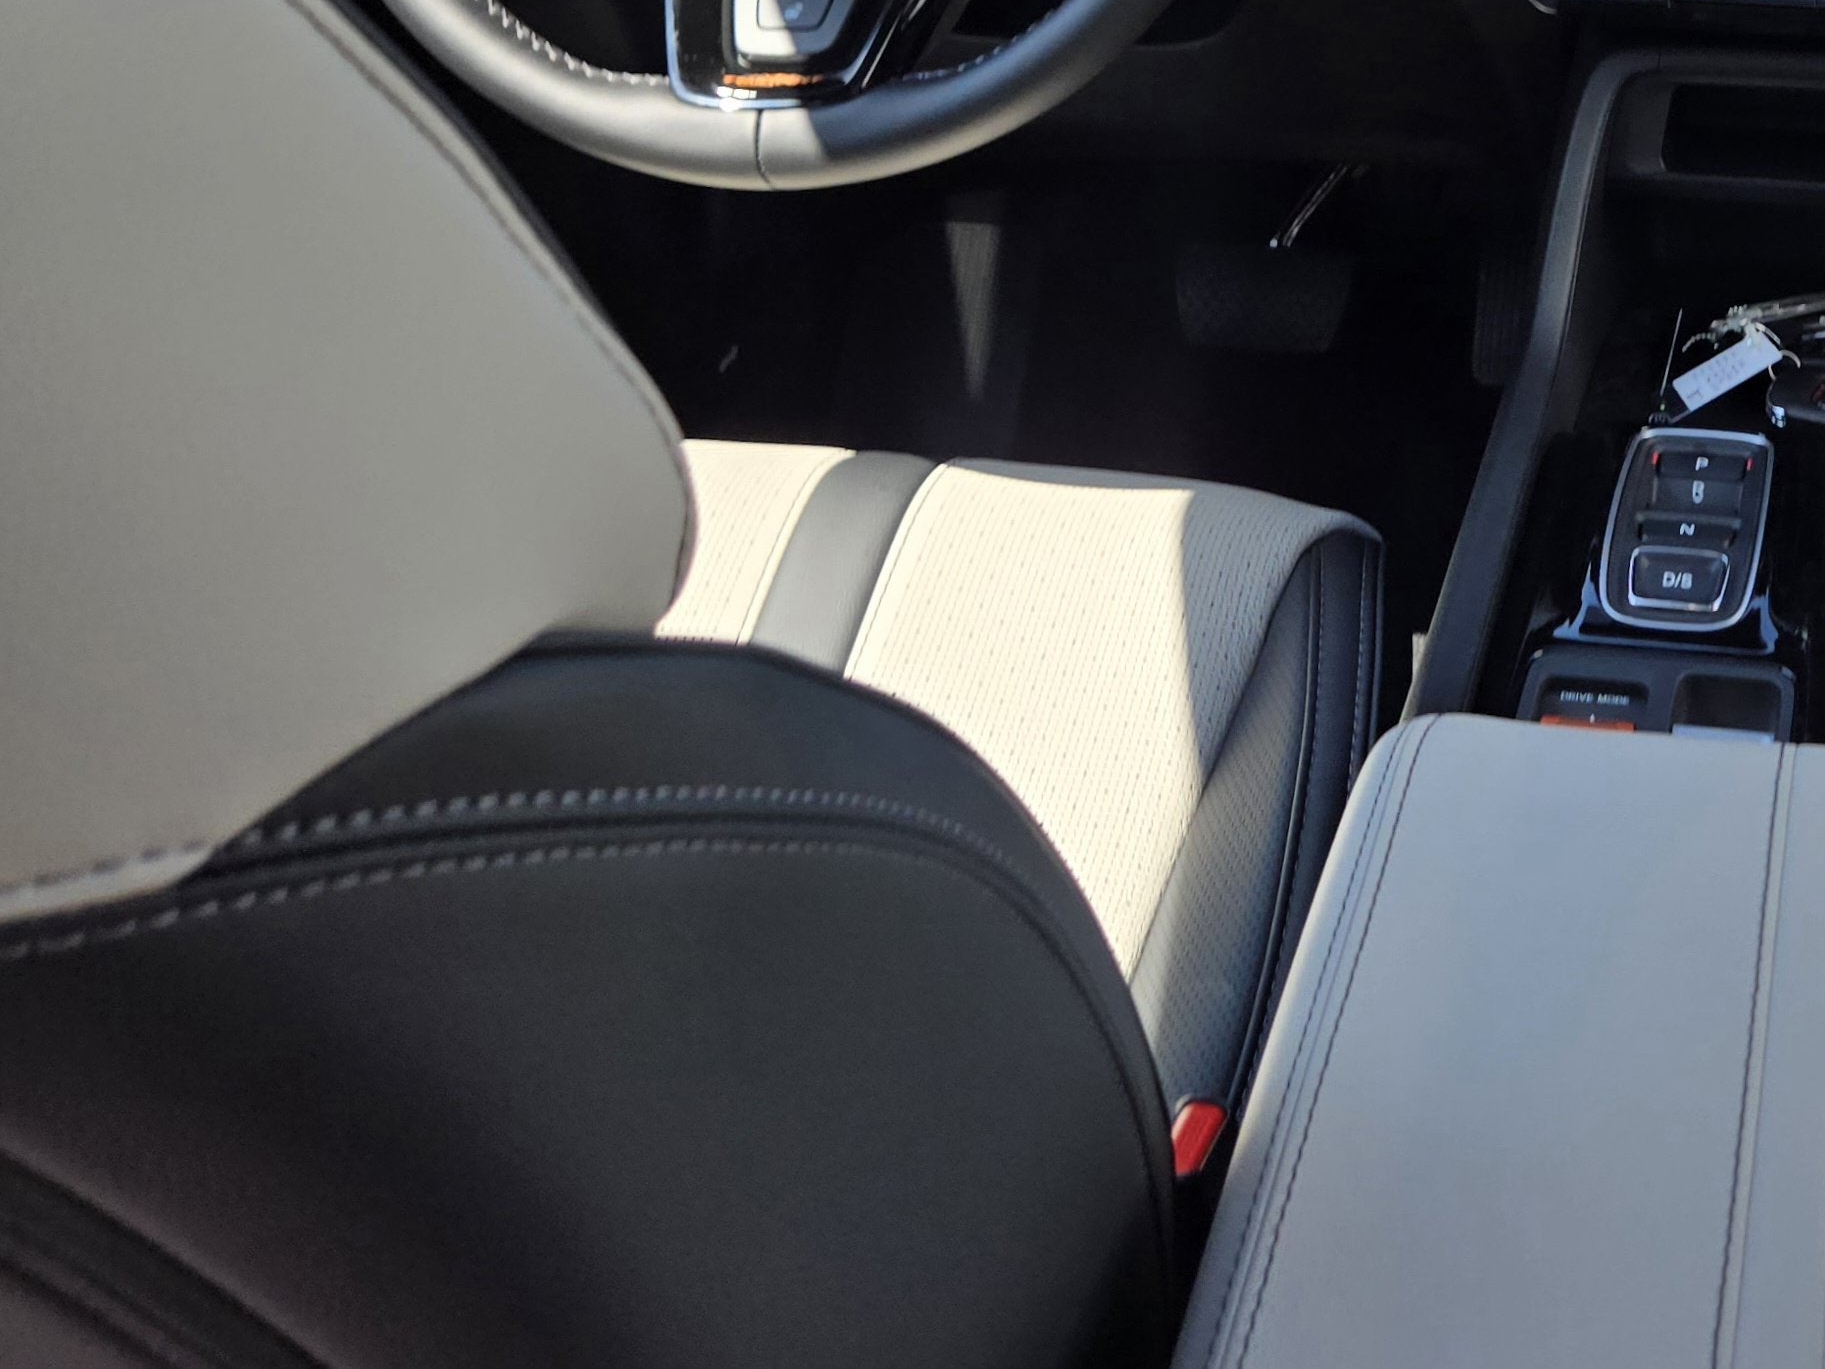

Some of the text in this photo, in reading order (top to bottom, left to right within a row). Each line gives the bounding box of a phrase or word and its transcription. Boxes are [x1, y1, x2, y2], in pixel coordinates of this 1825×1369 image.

[1695, 456, 1709, 471] P
[1679, 523, 1696, 536] N
[1662, 571, 1693, 590] D/B
[1560, 690, 1631, 706] DRIVE MODE
